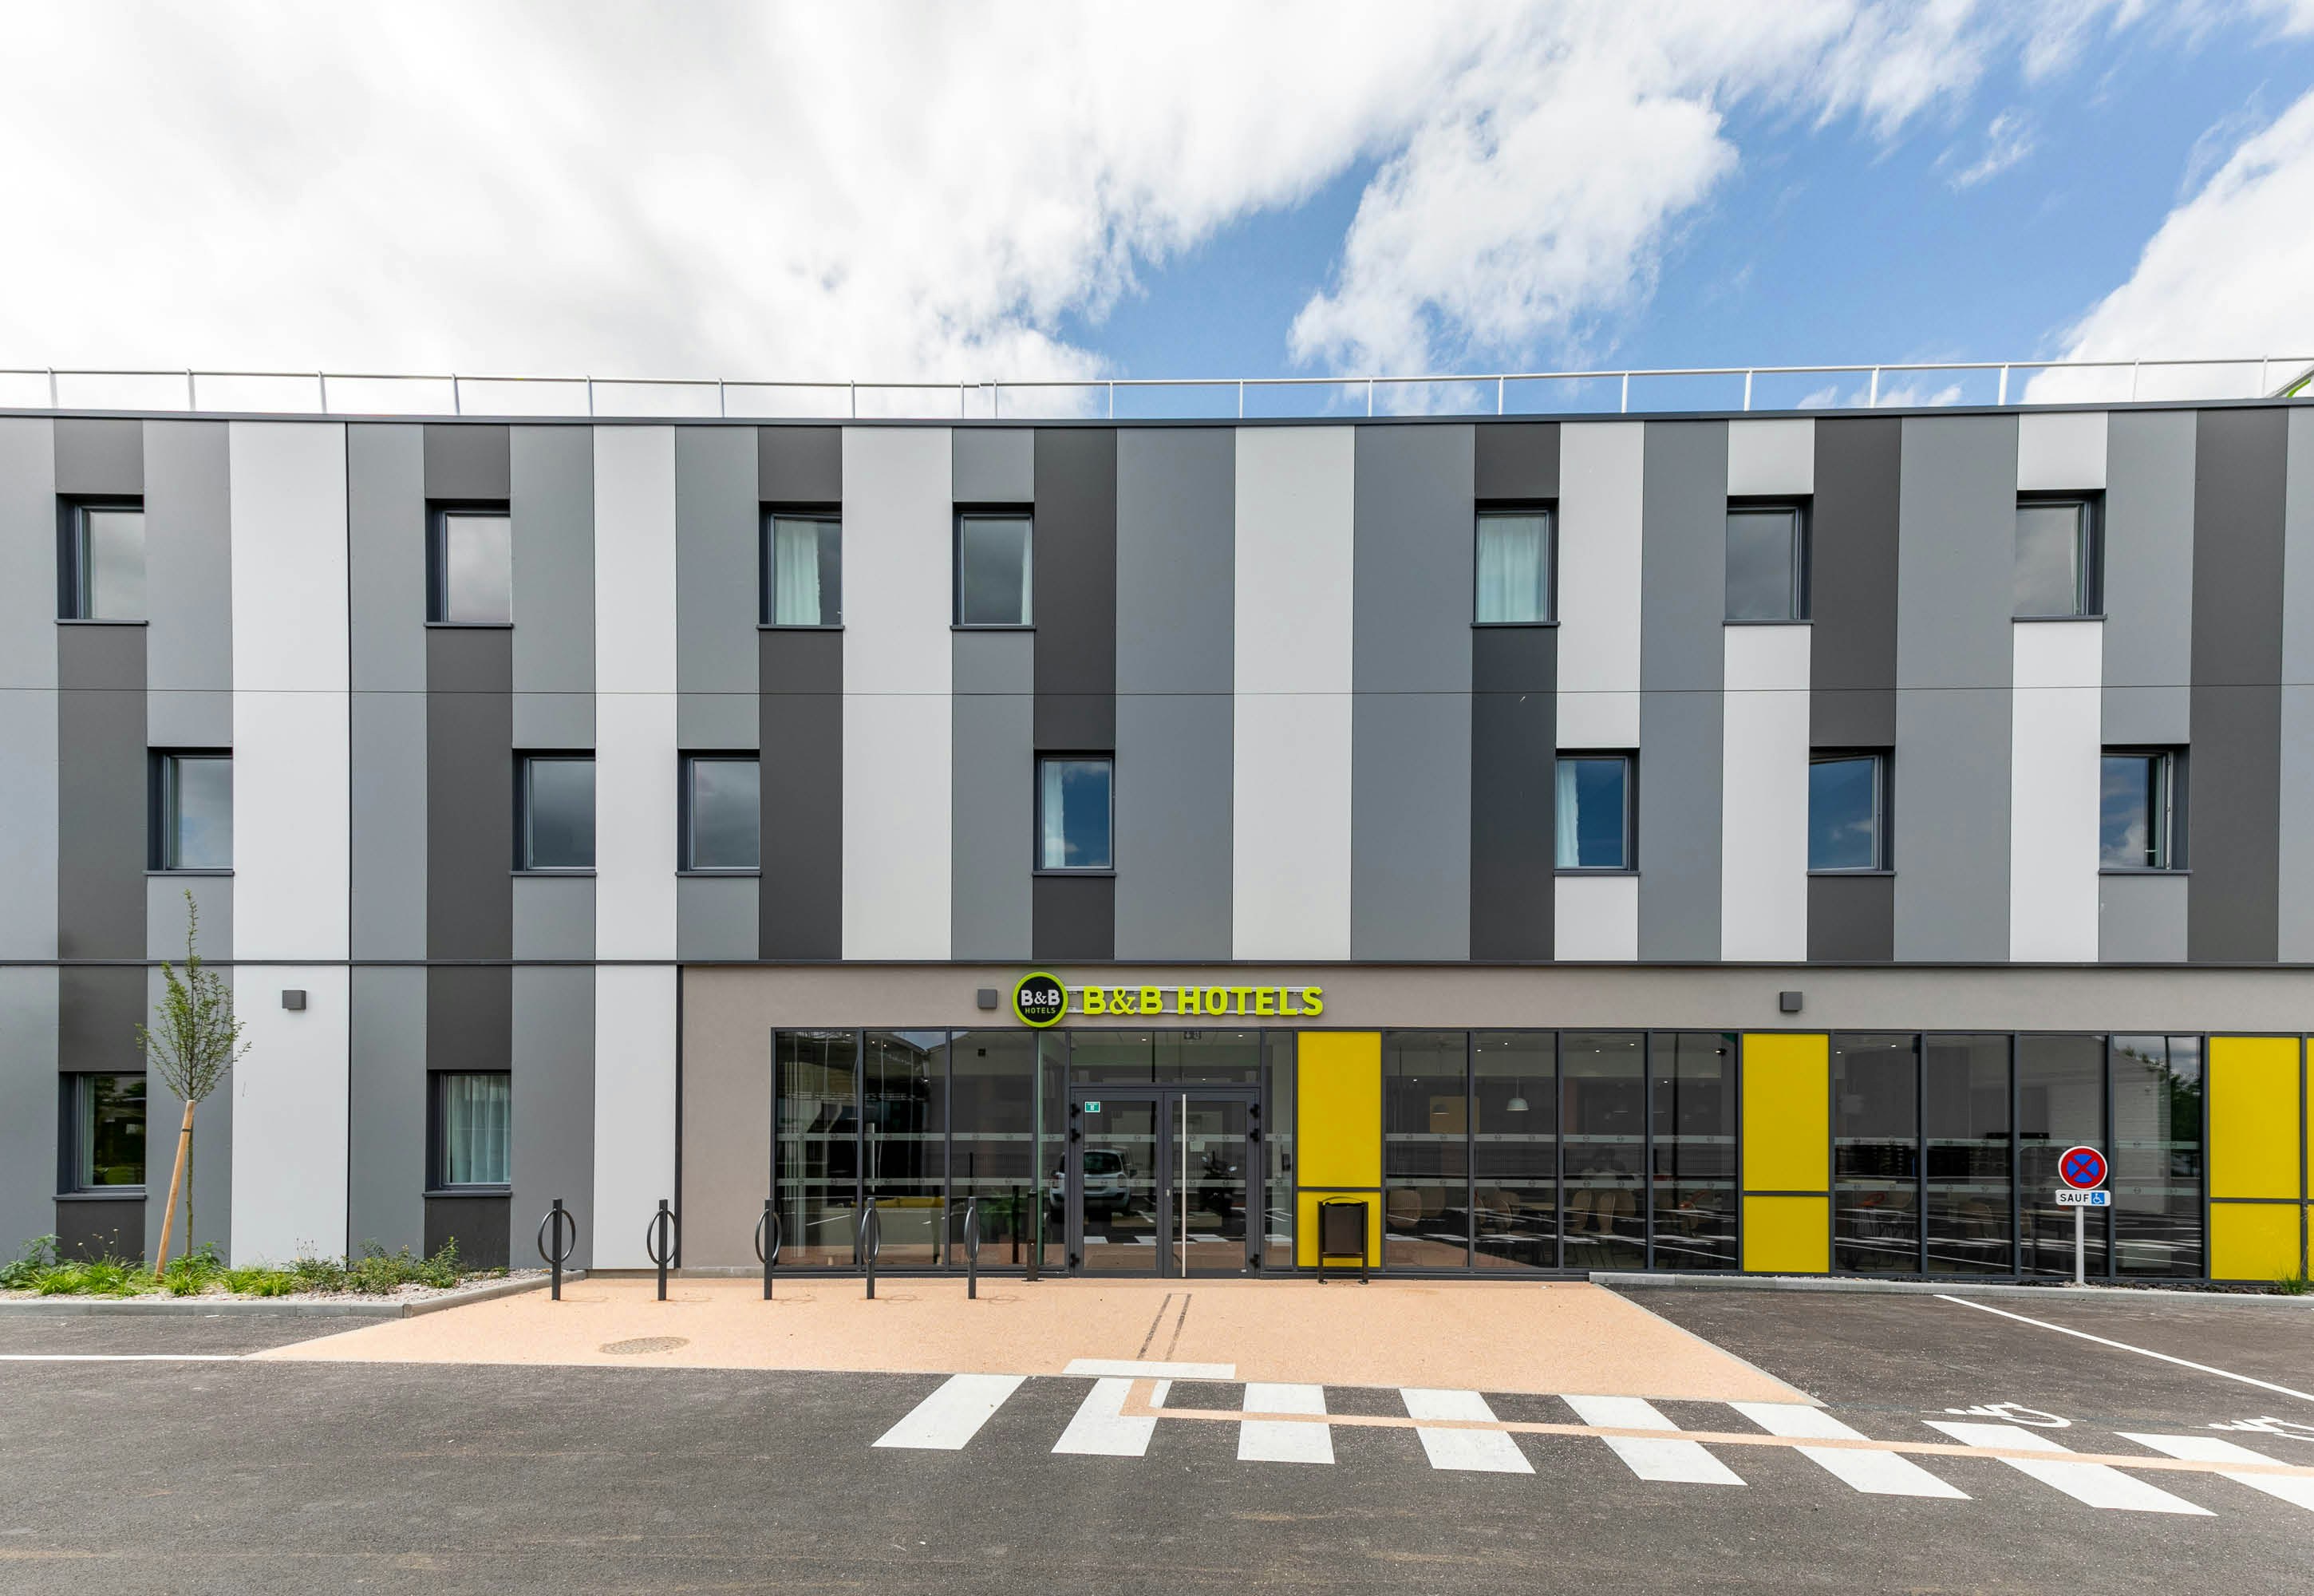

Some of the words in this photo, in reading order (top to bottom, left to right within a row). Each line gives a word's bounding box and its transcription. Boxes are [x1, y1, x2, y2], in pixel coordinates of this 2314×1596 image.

[1021, 990, 1060, 1006] B&B
[1084, 986, 1163, 1015] B&B
[1177, 986, 1323, 1016] HOTELS
